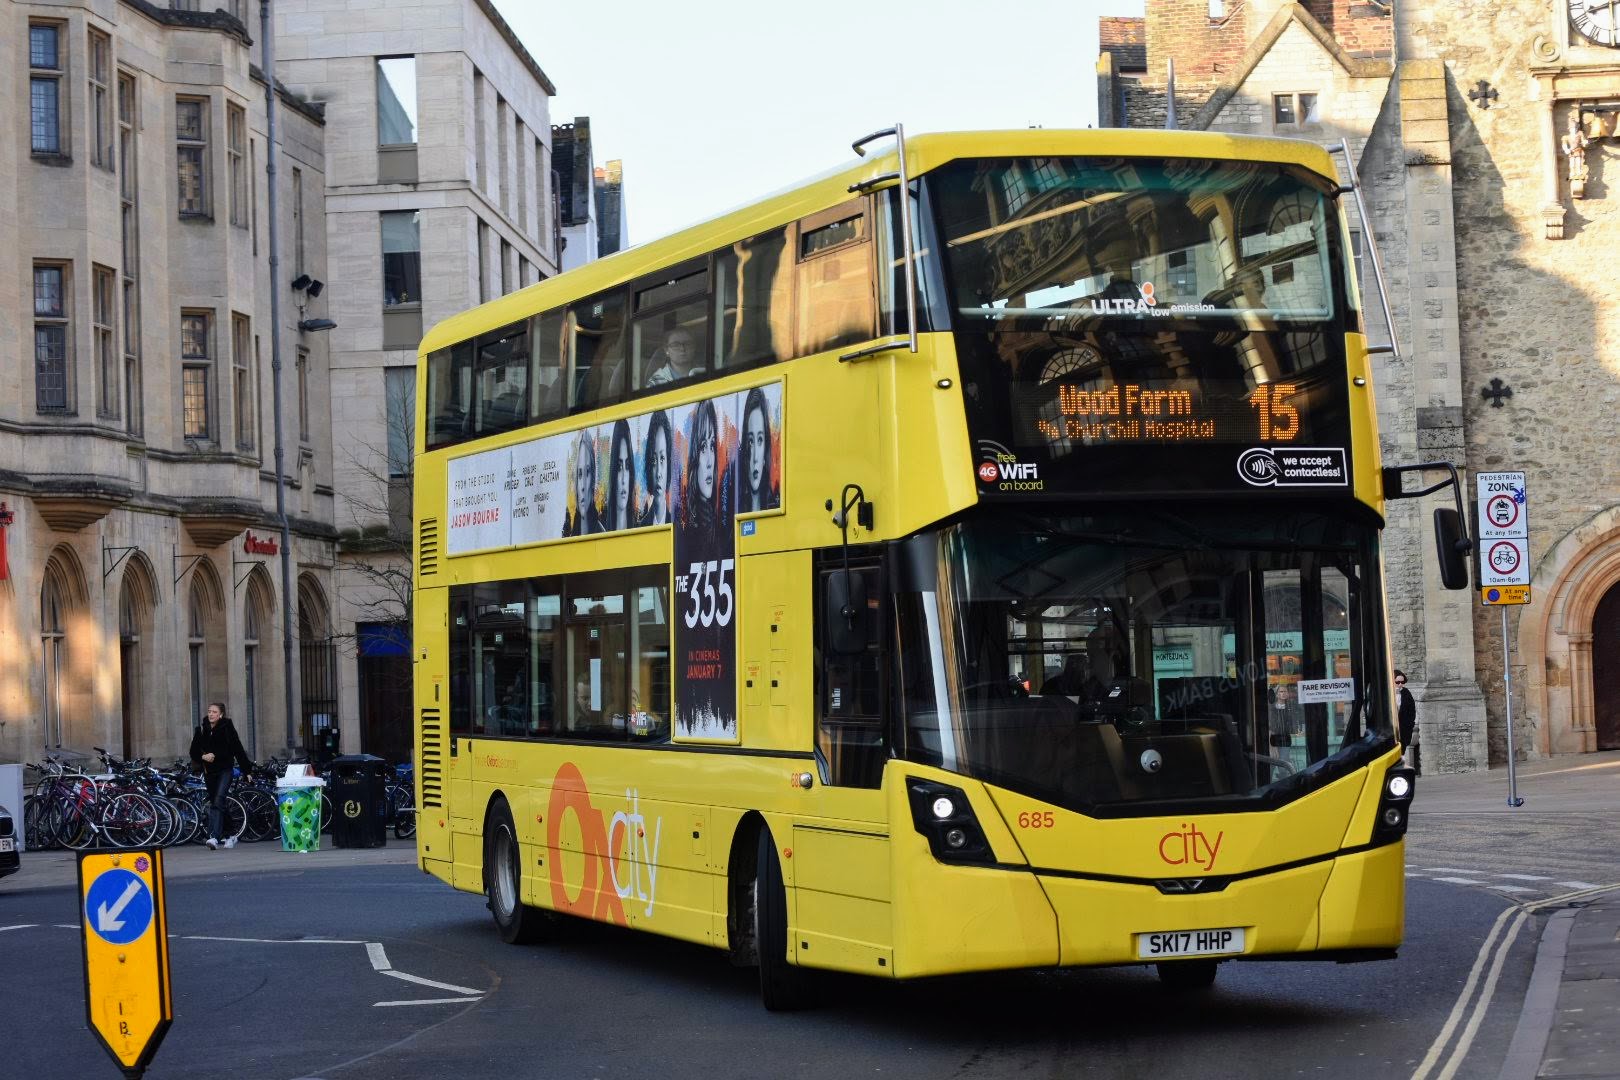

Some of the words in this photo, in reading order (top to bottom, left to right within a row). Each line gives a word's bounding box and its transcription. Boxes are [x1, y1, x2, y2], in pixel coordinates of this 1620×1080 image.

[1091, 298, 1150, 315] ULTRA
[1151, 307, 1170, 317] low
[1171, 302, 1215, 313] emission
[1059, 385, 1120, 415] Wood
[1125, 385, 1191, 415] Farm
[1249, 384, 1299, 440] 15
[1065, 420, 1139, 438] Churchill
[1145, 420, 1216, 440] Hospital
[997, 452, 1017, 463] free
[1300, 456, 1332, 467] accept
[979, 466, 998, 477] 4G
[999, 463, 1038, 479] WiFi
[1284, 467, 1341, 477] contactless!
[999, 482, 1013, 491] on
[1014, 480, 1043, 491] board
[1488, 482, 1515, 492] ZONE
[451, 513, 471, 529] JASON
[473, 508, 500, 525] BOURNE
[675, 575, 689, 593] THE
[684, 558, 734, 629] 355
[688, 651, 695, 660] IN
[695, 649, 720, 662] CINEMAS
[687, 665, 715, 679] JANUARY
[1302, 683, 1319, 691] FARE
[1320, 681, 1351, 690] REVISION
[1018, 811, 1055, 829] 685
[1159, 823, 1224, 872] city
[1149, 934, 1191, 954] SK17
[1196, 930, 1232, 951] HHP
